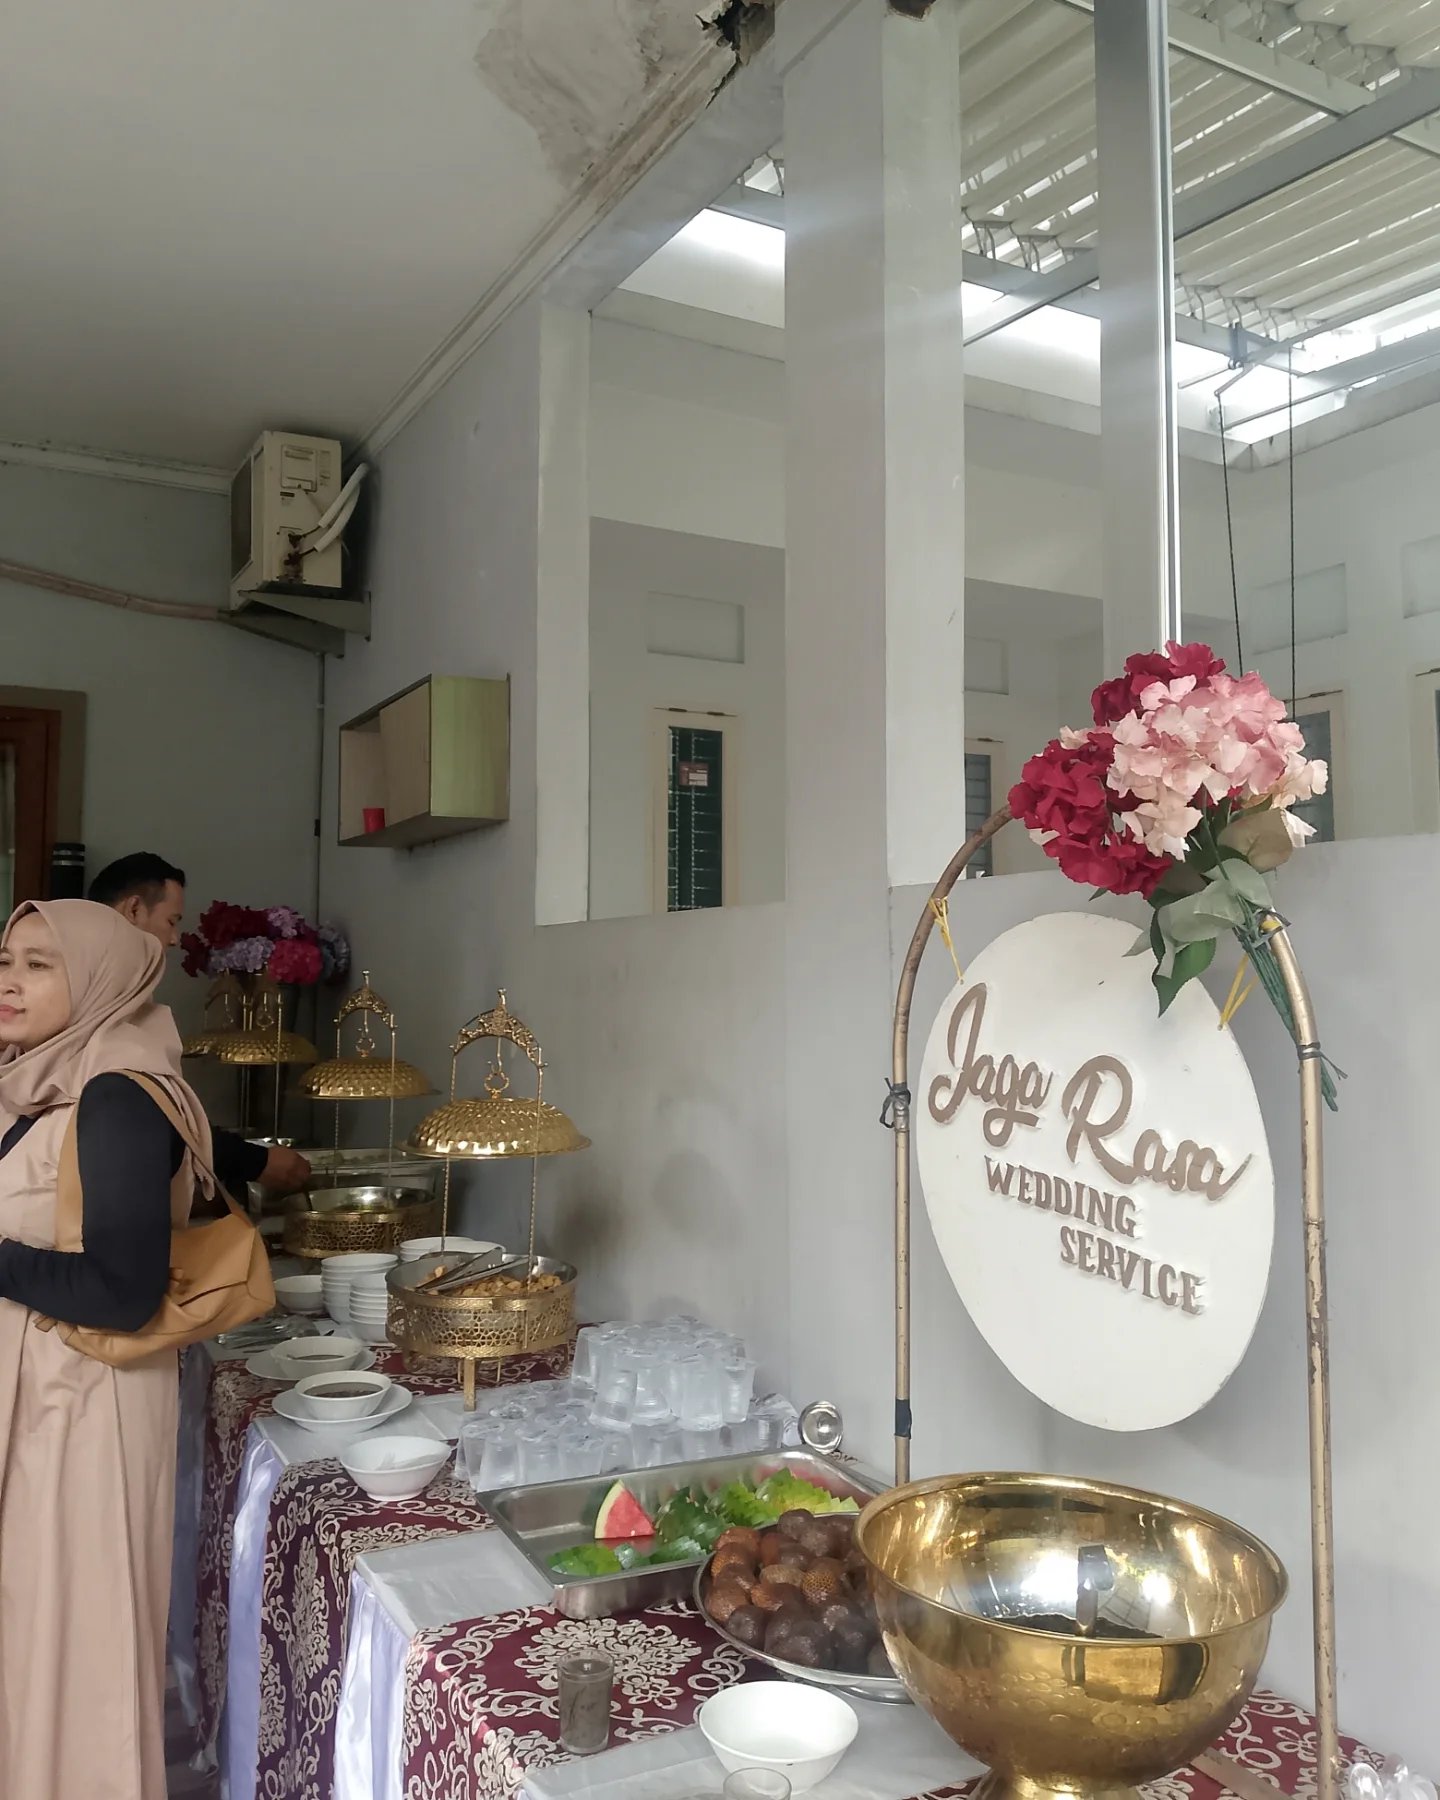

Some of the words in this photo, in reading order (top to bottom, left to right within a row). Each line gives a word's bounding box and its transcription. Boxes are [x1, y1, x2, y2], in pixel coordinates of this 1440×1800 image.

[928, 982, 1053, 1147] Jaga
[1061, 1055, 1252, 1201] Rasa
[984, 1155, 1139, 1238] WEDDING
[1060, 1225, 1204, 1315] SERVICE
